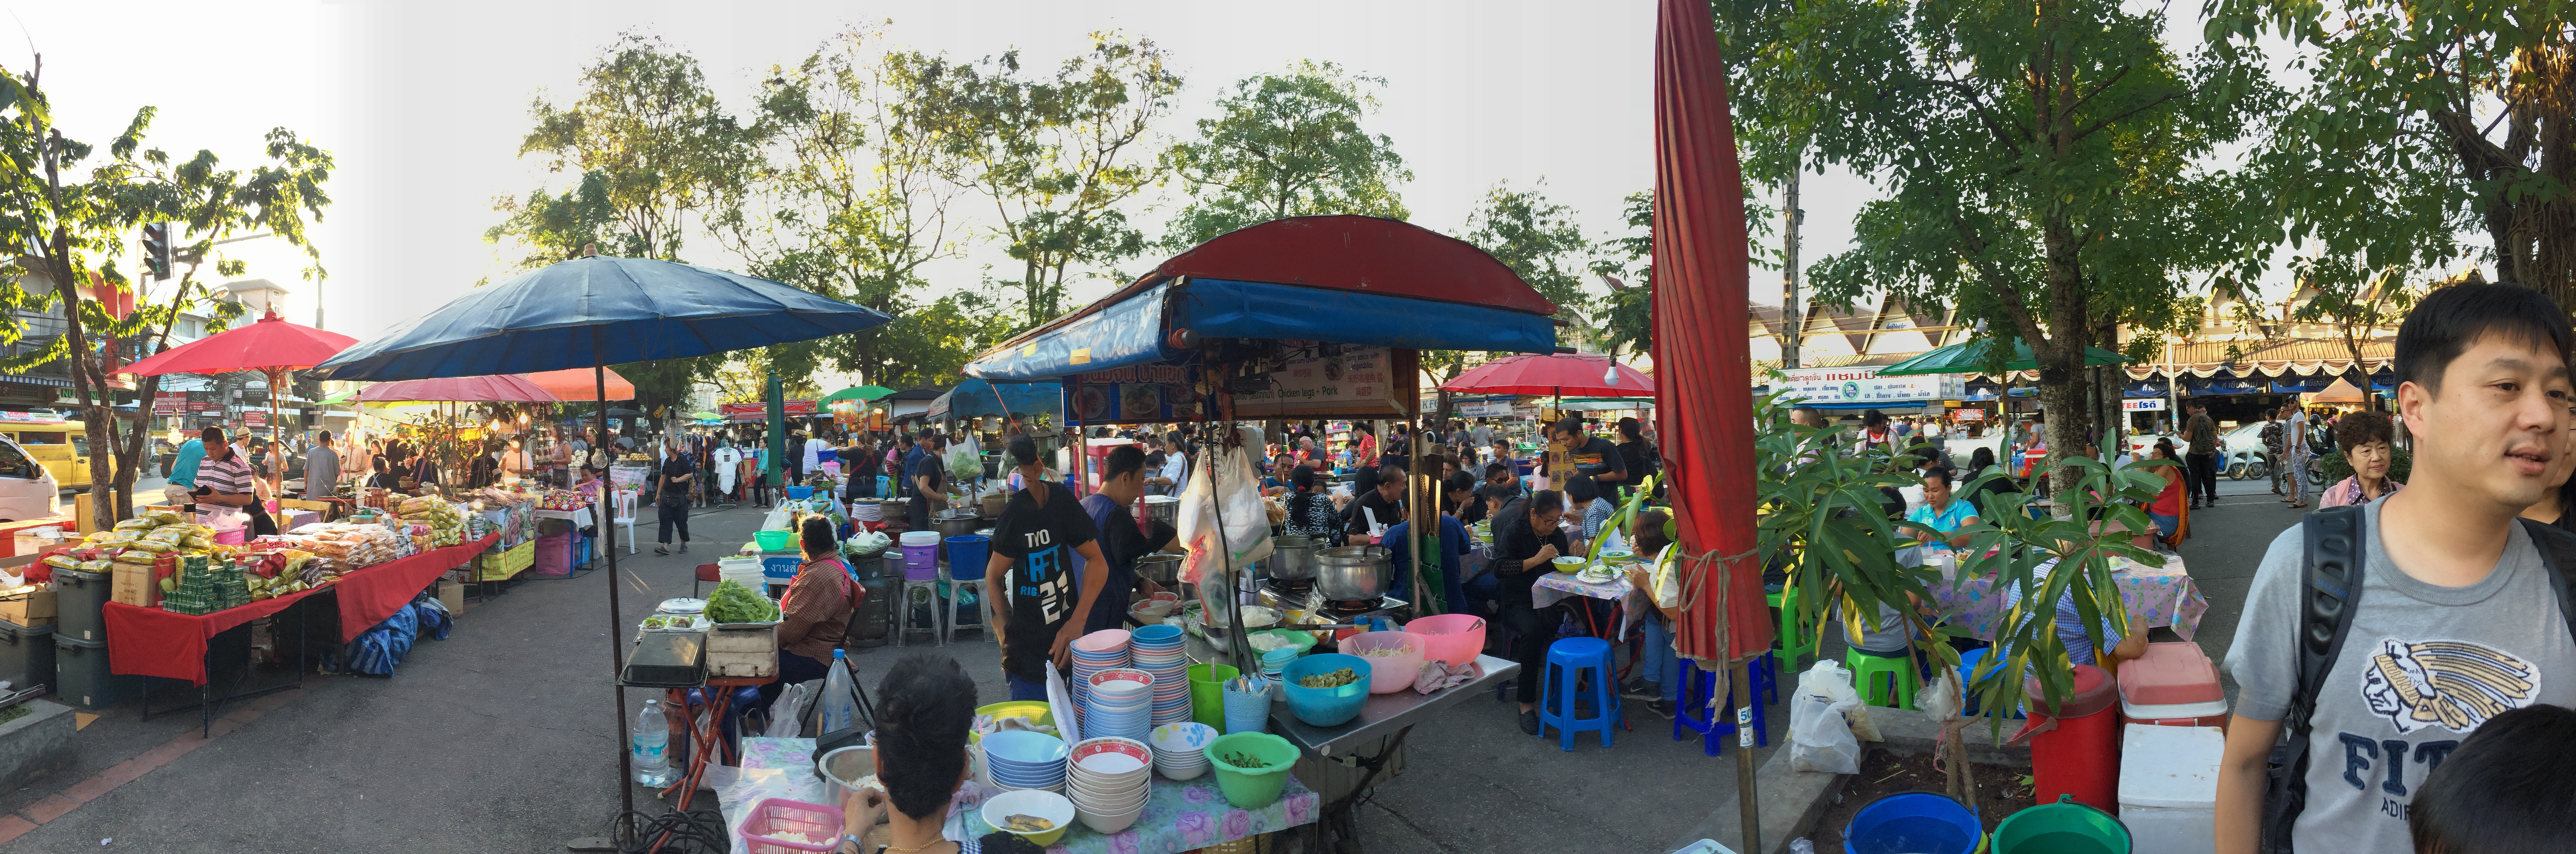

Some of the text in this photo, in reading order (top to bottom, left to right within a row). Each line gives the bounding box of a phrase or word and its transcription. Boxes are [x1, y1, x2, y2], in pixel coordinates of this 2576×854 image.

[1346, 354, 1356, 362] curry
[1351, 361, 1373, 370] vegetables
[1278, 388, 1300, 398] Chicken
[1302, 387, 1314, 399] legs
[1322, 385, 1338, 395] Pork
[771, 560, 799, 573] งานสั
[1740, 709, 1751, 721] 50
[2338, 732, 2459, 797] FIT
